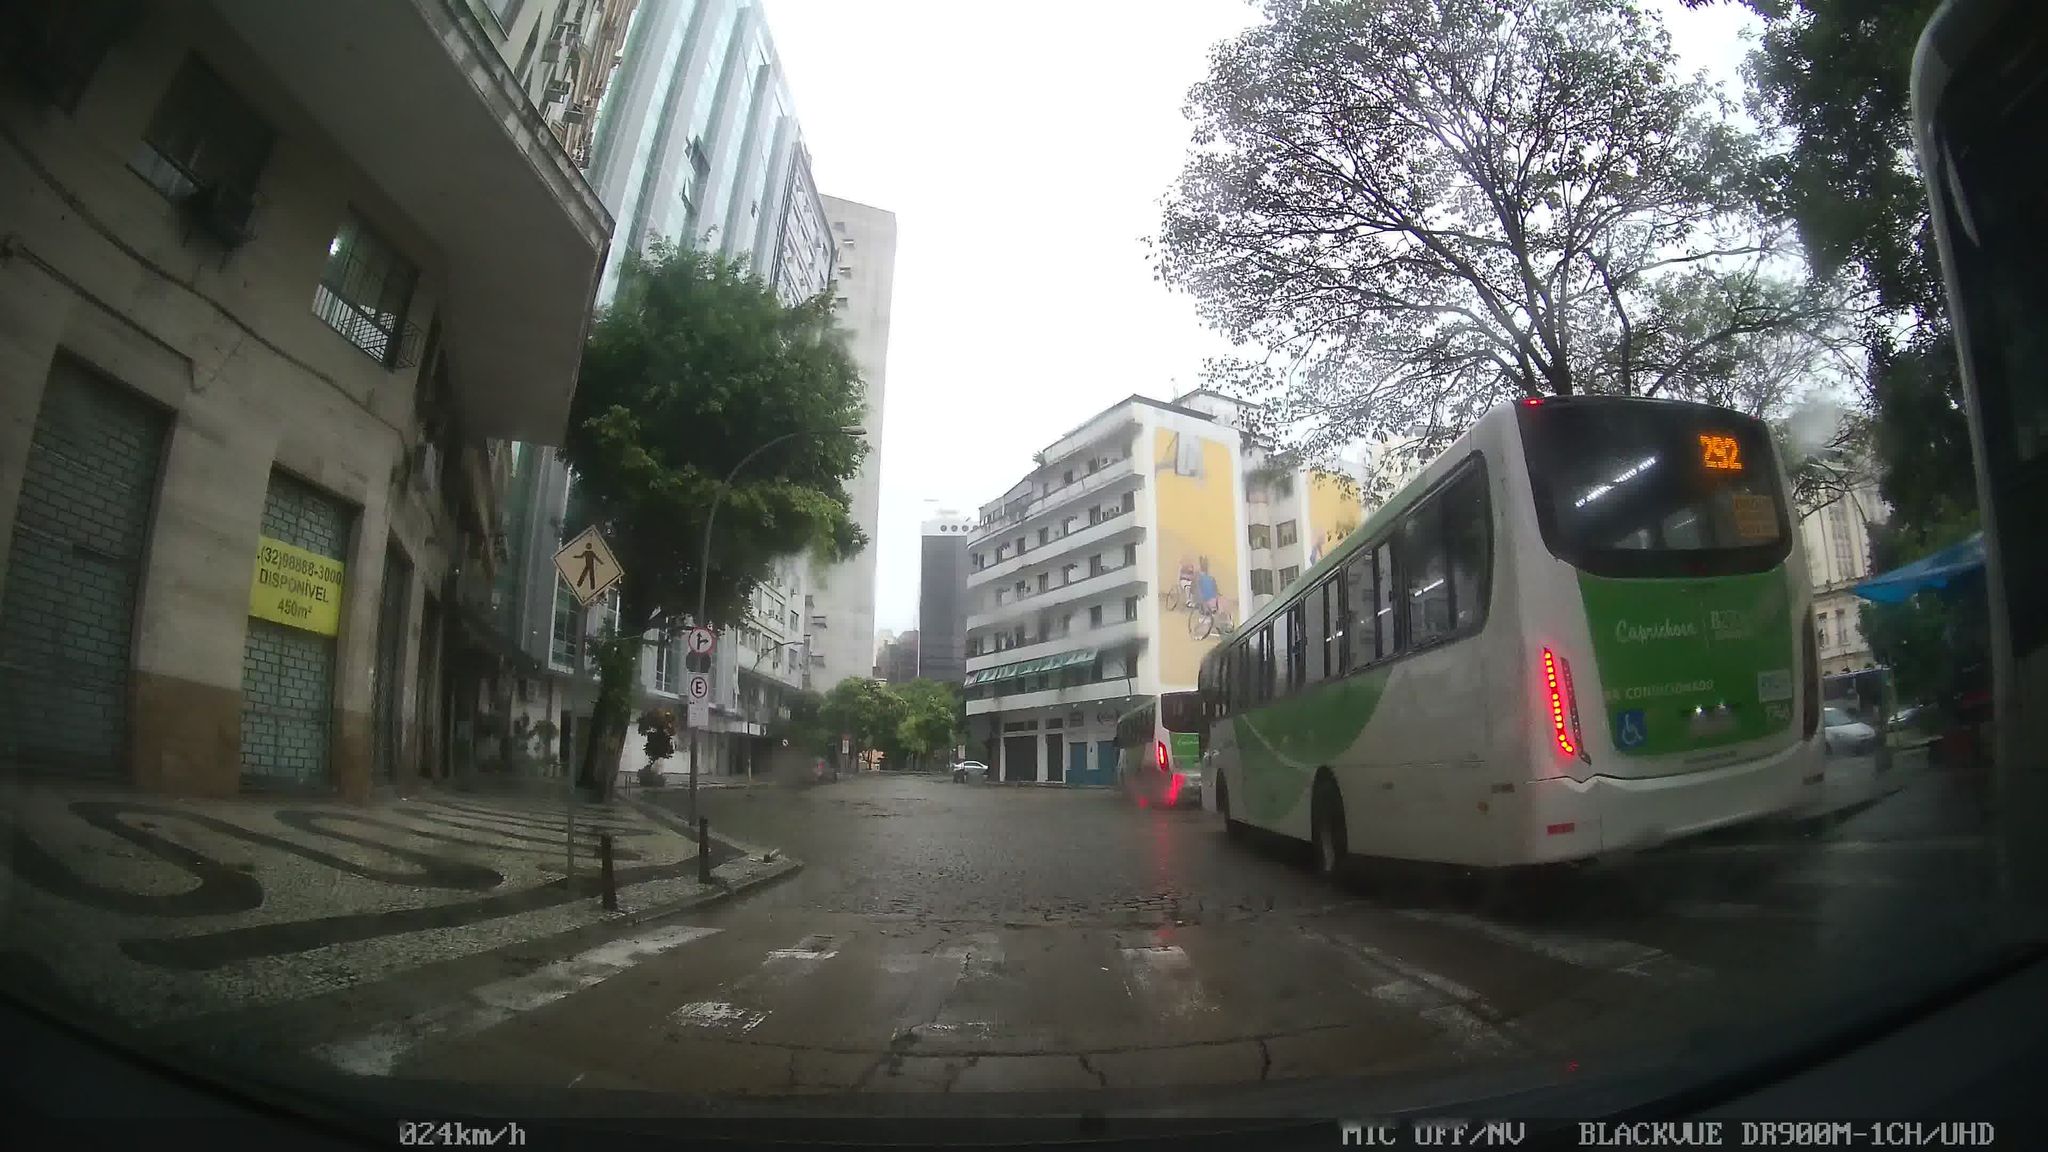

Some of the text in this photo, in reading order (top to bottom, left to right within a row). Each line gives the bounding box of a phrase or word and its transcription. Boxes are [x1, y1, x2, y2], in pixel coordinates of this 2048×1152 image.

[1699, 434, 1743, 470] 292
[259, 568, 329, 603] DISPONÍVEL
[695, 681, 703, 694] E
